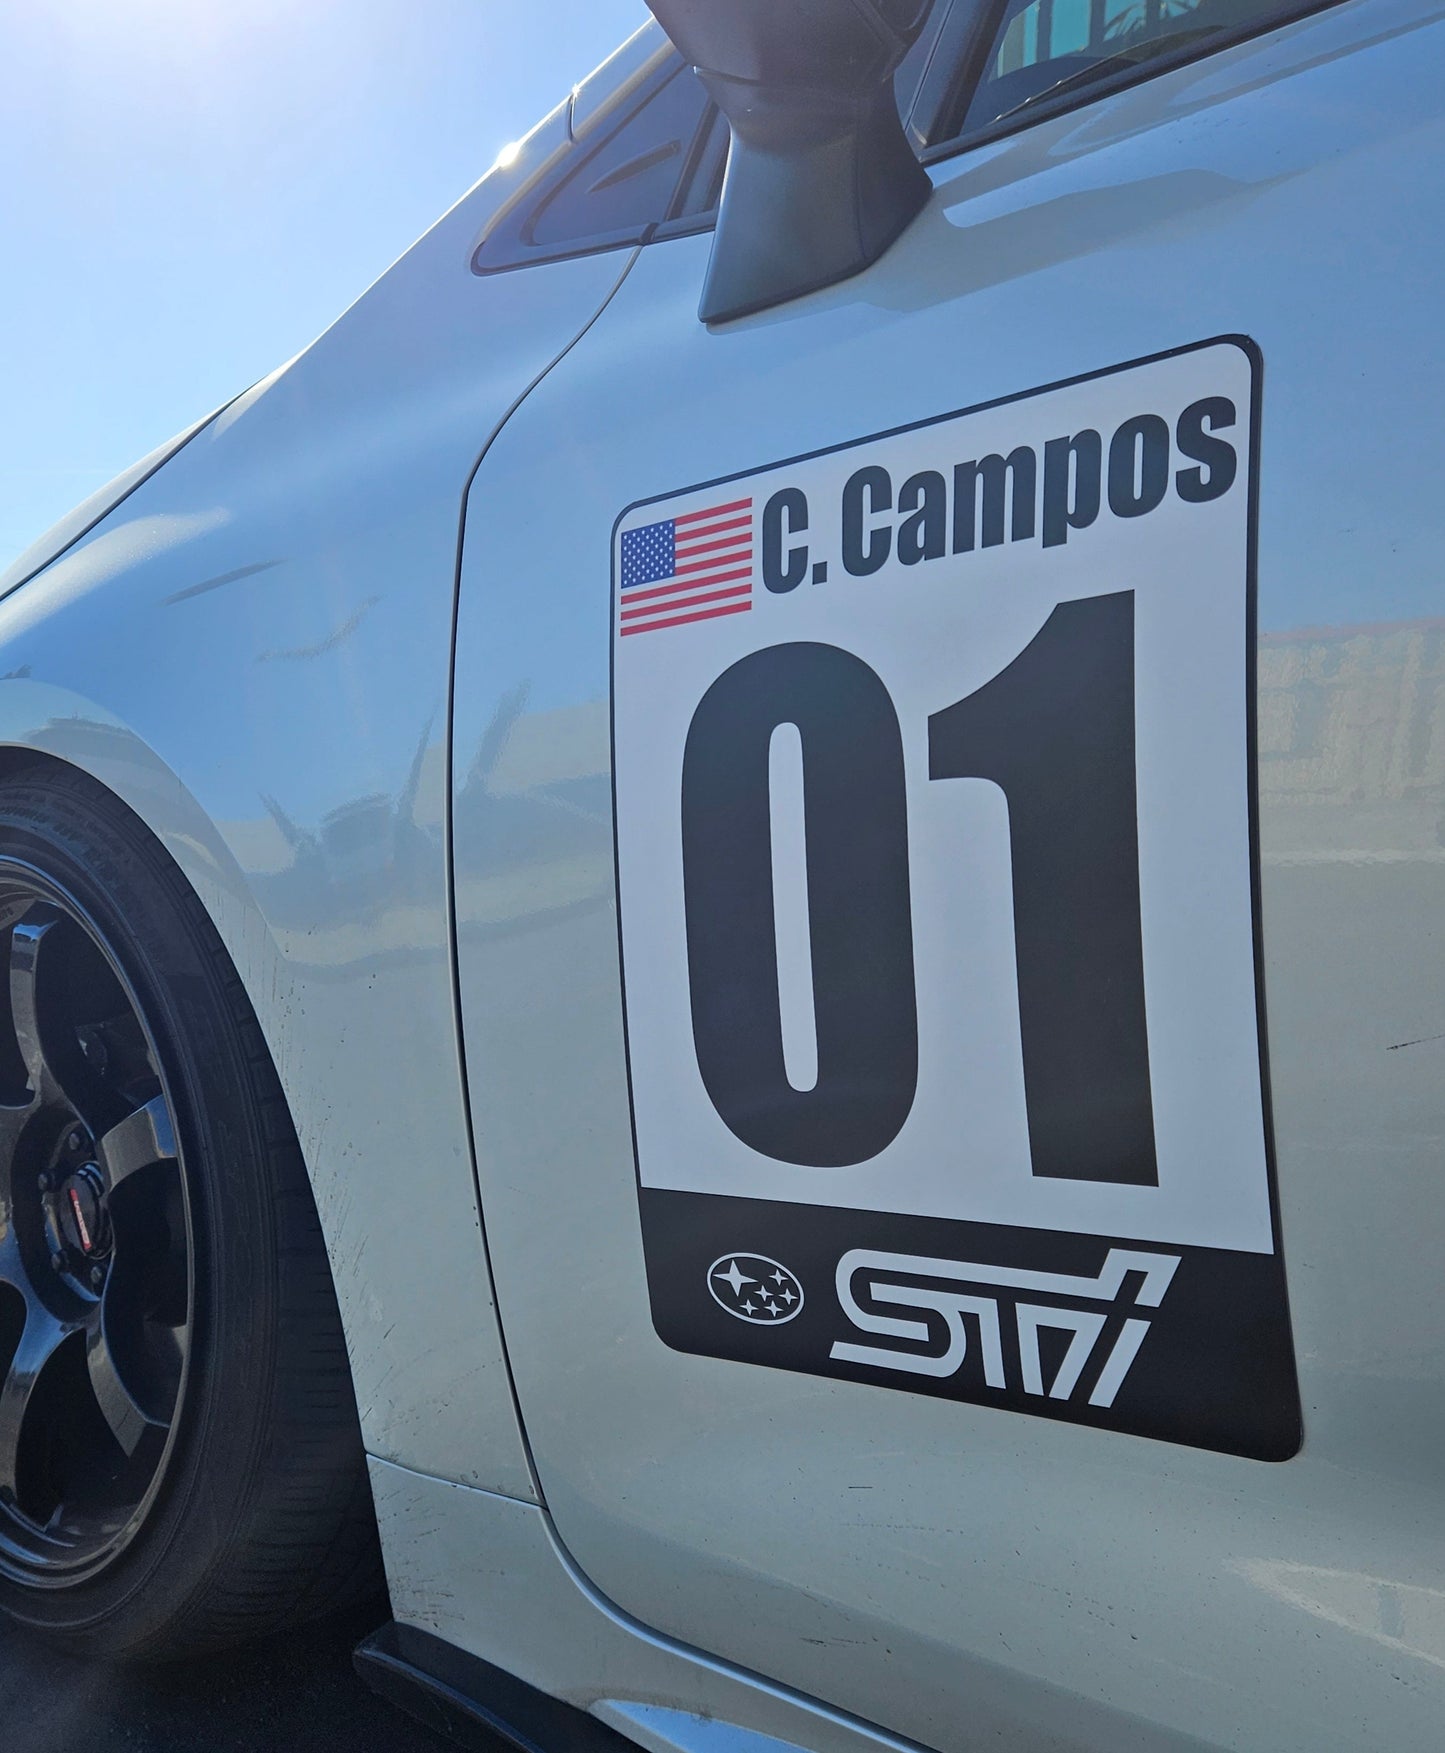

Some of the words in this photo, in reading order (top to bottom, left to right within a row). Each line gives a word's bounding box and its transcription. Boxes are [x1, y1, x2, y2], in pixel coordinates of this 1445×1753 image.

[762, 487, 828, 595] C.
[842, 395, 1238, 577] Campos
[680, 588, 1160, 1188] 01
